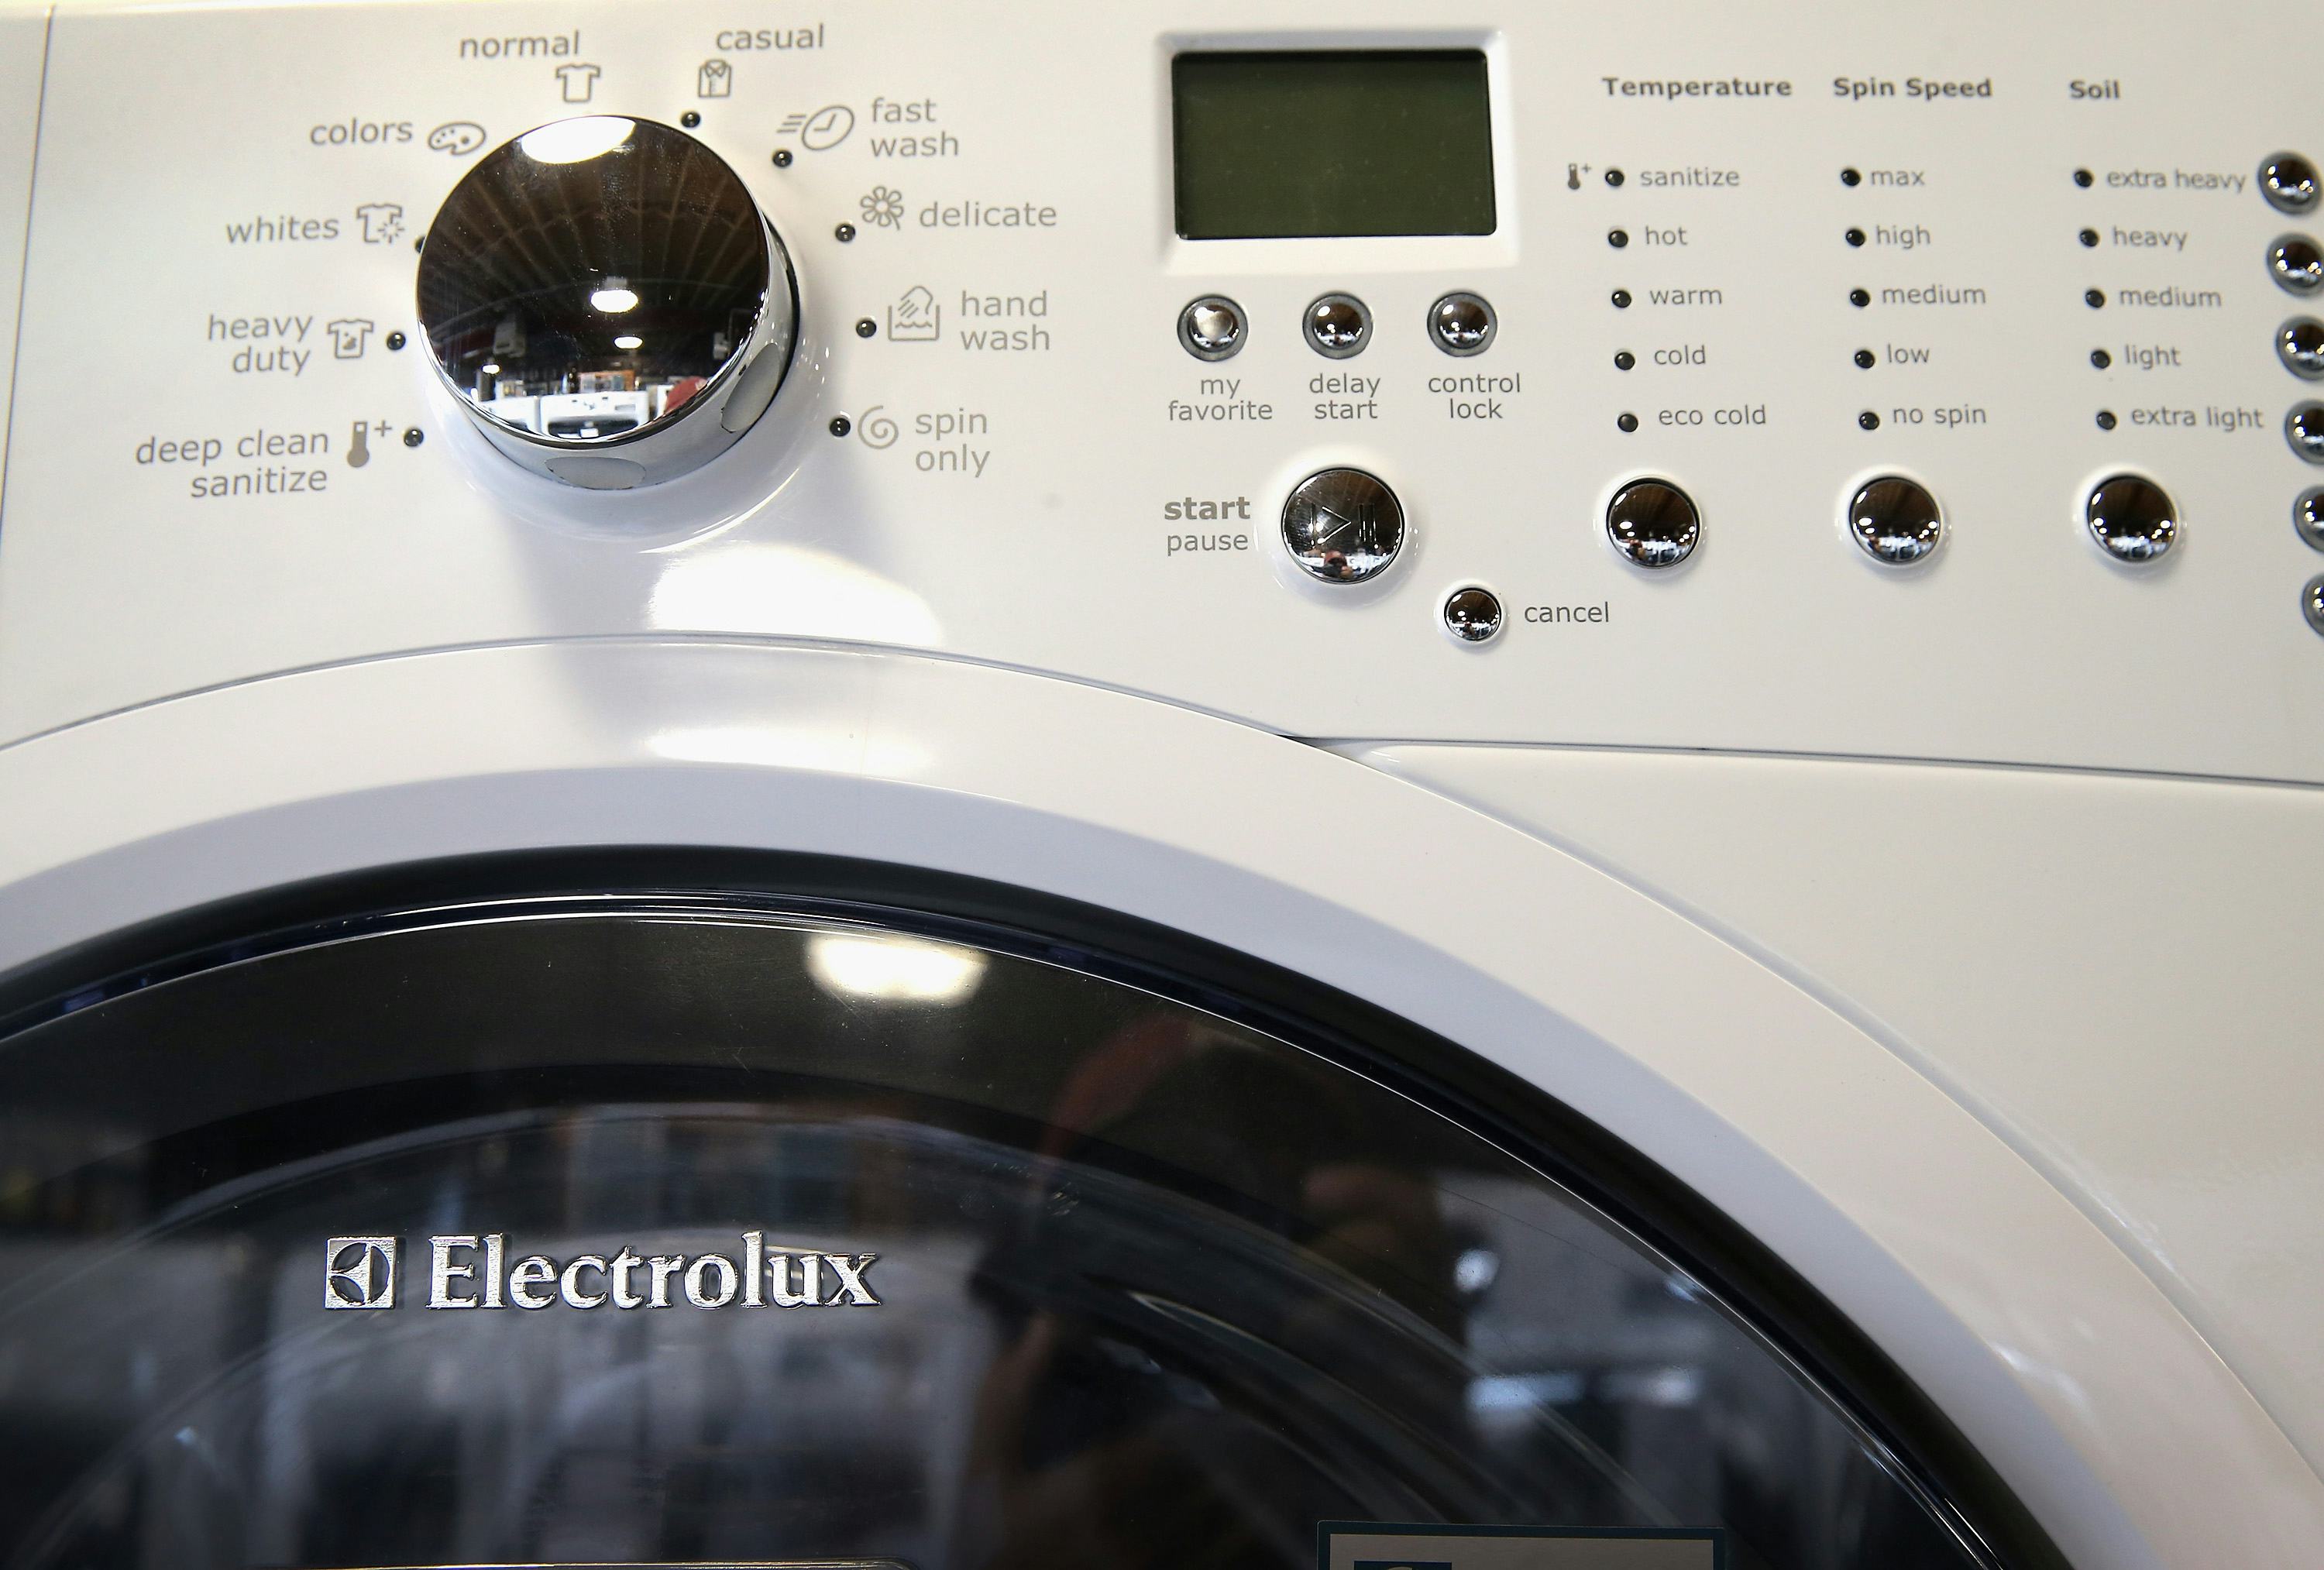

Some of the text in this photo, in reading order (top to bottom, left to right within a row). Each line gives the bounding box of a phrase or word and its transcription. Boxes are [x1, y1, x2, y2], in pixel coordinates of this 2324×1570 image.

[460, 29, 579, 59] normal
[716, 22, 824, 51] casual
[1602, 77, 1792, 101] Temperature
[1833, 77, 1992, 101] Spin Speed
[2069, 80, 2120, 100] Soil
[871, 97, 936, 123] fast
[309, 117, 413, 146] colors
[871, 130, 959, 157] wash
[1640, 167, 1740, 187] sanitize
[1870, 170, 1925, 187] max
[2106, 169, 2247, 194] extra heavy
[919, 201, 1057, 228] delicate
[226, 215, 339, 244] whites
[1645, 225, 1688, 246] hot
[1875, 225, 1930, 250] high
[2113, 226, 2188, 252] heavy
[961, 290, 1047, 317] hand
[1649, 290, 1722, 305] warm
[1882, 284, 1986, 304] medium
[2119, 287, 2222, 307] medium
[208, 314, 313, 343] heavy
[960, 324, 1050, 351] wash
[232, 345, 311, 377] duty
[1654, 345, 1706, 366] cold
[1887, 343, 1930, 364] low
[2125, 345, 2181, 371] light
[1201, 379, 1240, 400] my
[1309, 373, 1380, 398] delay
[1428, 373, 1520, 393] control
[1168, 400, 1273, 421] favorite
[1315, 400, 1378, 420] start
[1450, 398, 1503, 419] lock
[1659, 404, 1766, 426] eco cold
[1893, 404, 1986, 428] no spin
[2131, 407, 2264, 433] extra light
[916, 407, 987, 441] spin
[136, 429, 328, 467] deep clean
[916, 443, 990, 478] only
[191, 466, 327, 499] sanitize
[1164, 496, 1250, 520] start
[1167, 534, 1248, 556] pause
[1525, 601, 1609, 623] cancel
[426, 1231, 882, 1310] Electrolux
